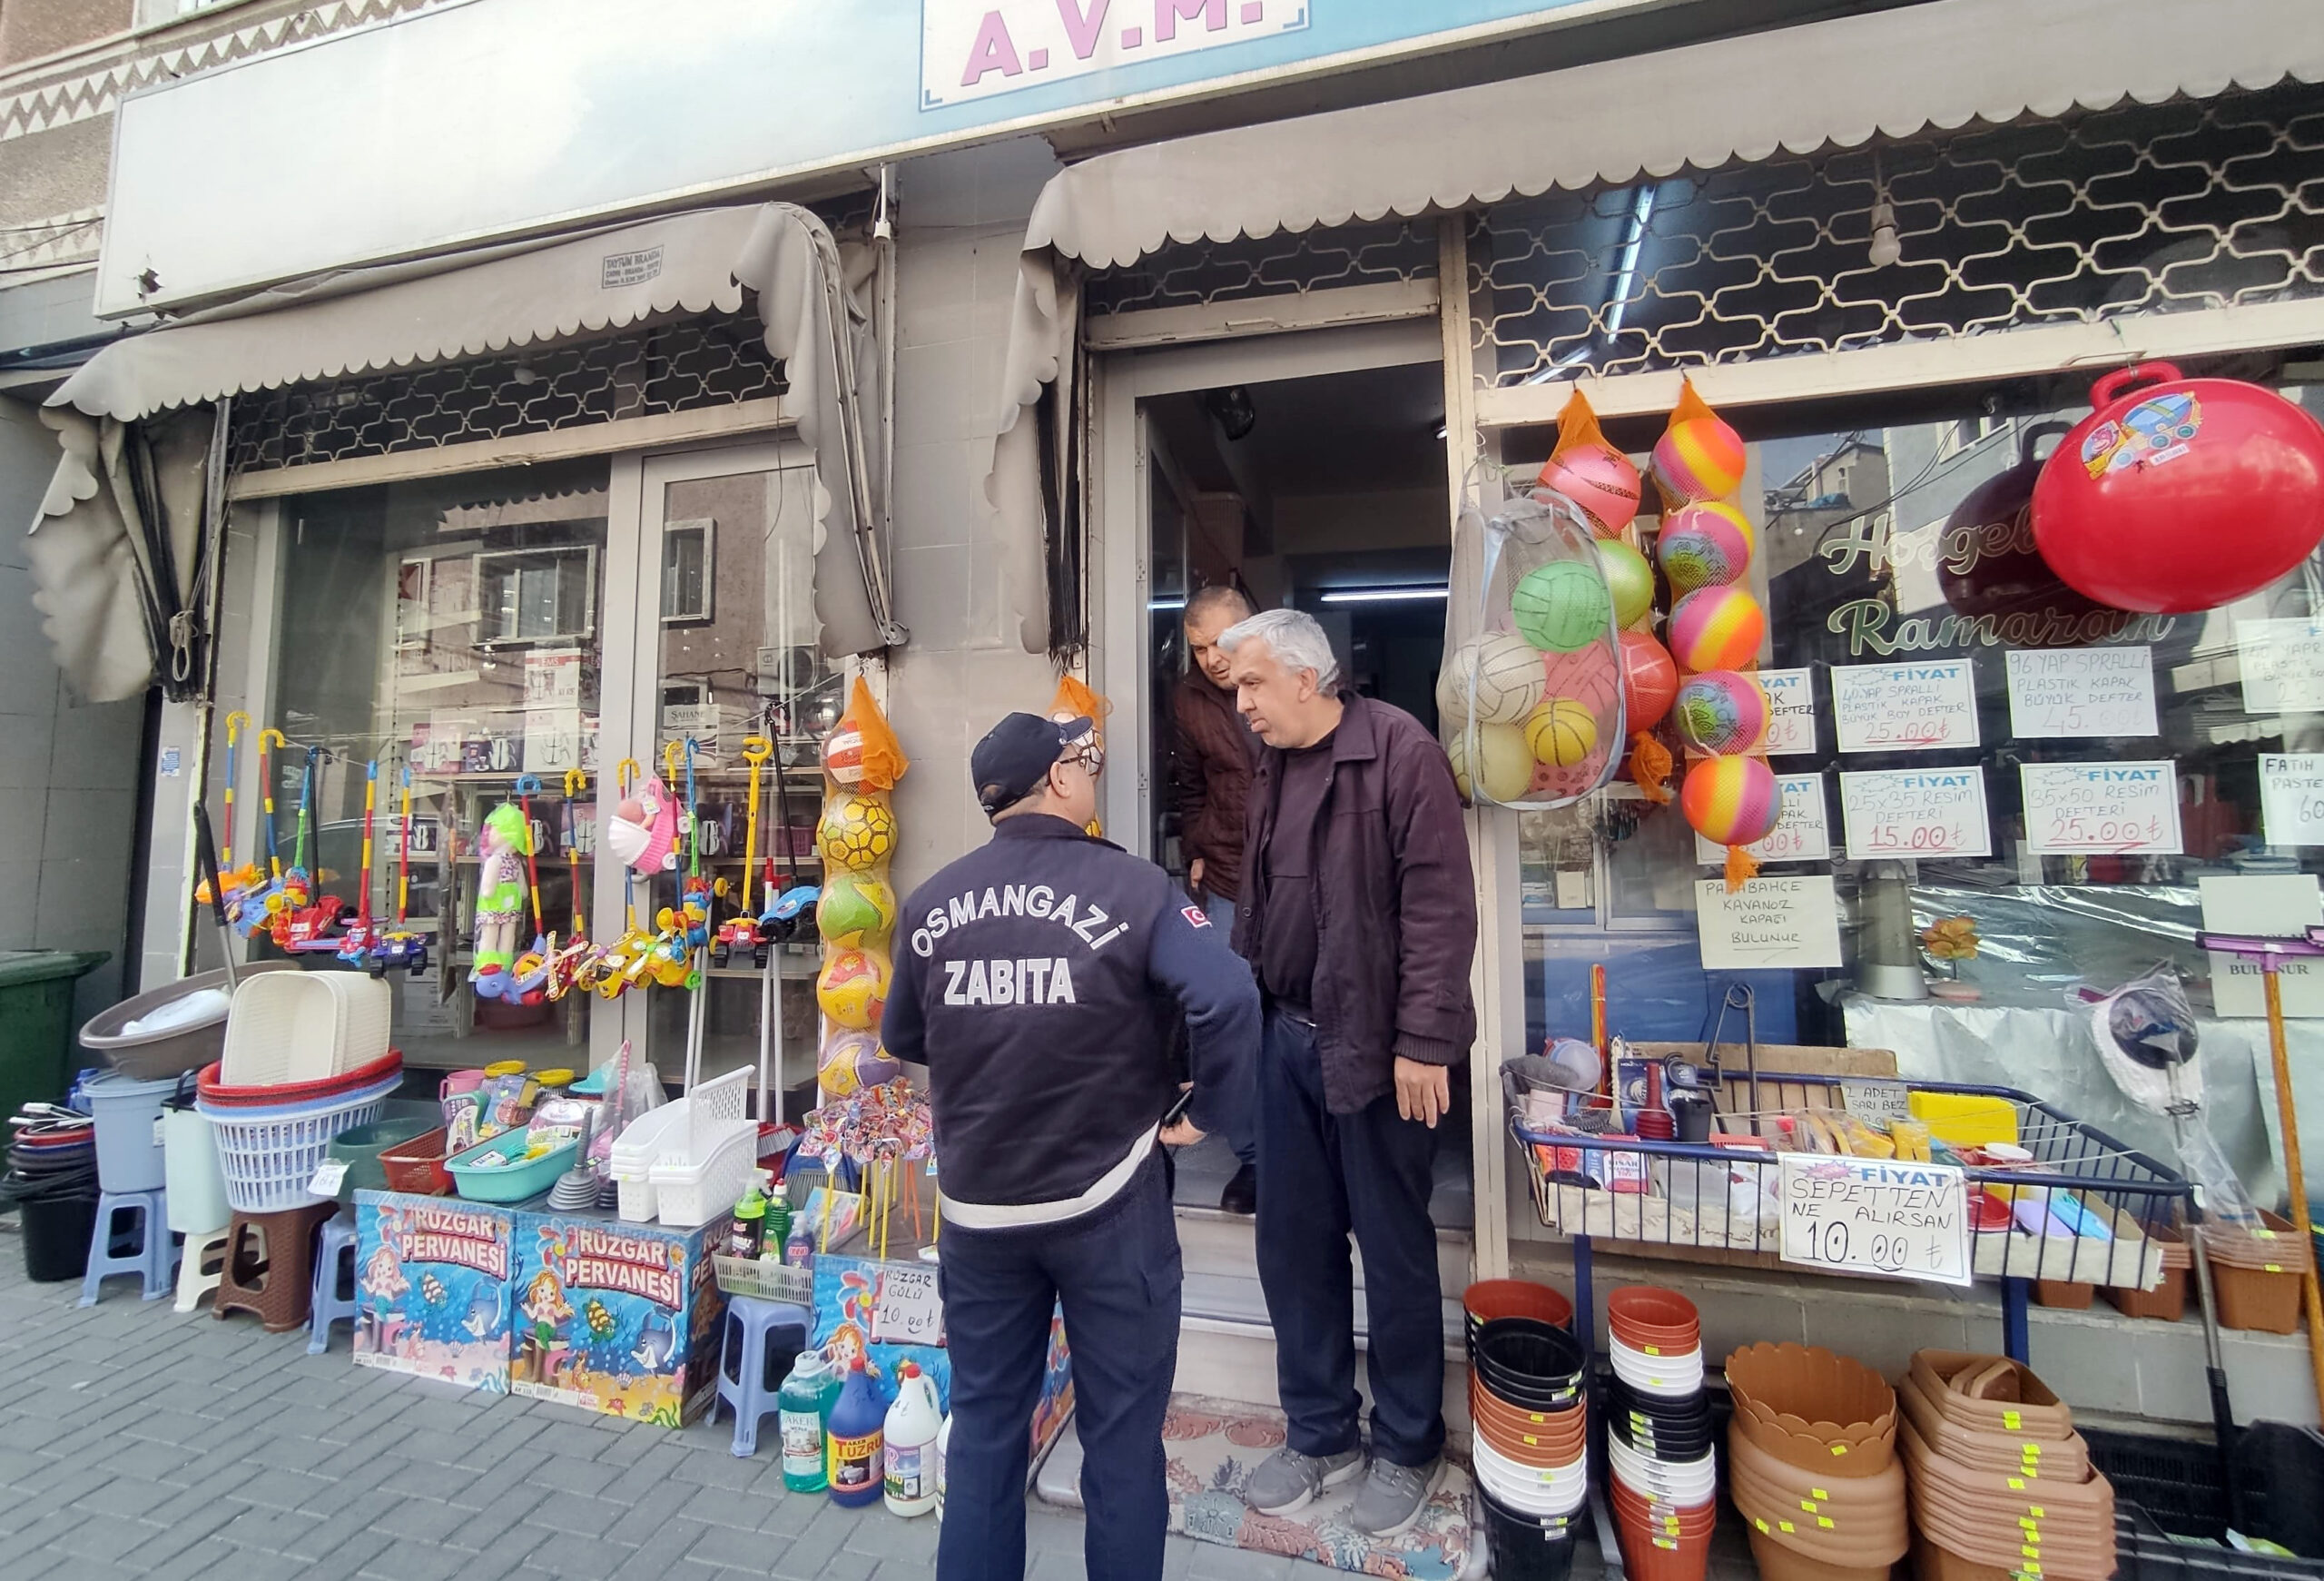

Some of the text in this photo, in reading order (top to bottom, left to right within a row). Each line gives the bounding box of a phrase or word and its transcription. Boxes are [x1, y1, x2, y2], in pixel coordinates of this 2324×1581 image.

[960, 0, 1264, 86] A.V.M.
[1821, 503, 2036, 575] Hoşgel
[1827, 598, 2176, 656] Ramazan
[2280, 641, 2321, 656] YAPR
[2010, 652, 2034, 675] 96
[2038, 652, 2071, 674] YAP
[1893, 667, 1960, 681] FİYAT
[1760, 677, 1800, 687] YAT
[2091, 676, 2138, 690] KAPAK
[1902, 694, 1944, 707] KAPAK
[2088, 691, 2143, 704] DEFTER
[1888, 710, 1910, 720] BOY
[1918, 702, 1968, 716] DEFTER
[1904, 775, 1971, 788] FİYAT
[2088, 768, 2161, 781] FİYAT
[2271, 777, 2324, 792] PASTE
[2299, 795, 2324, 823] 60
[1706, 881, 1803, 896] PAABAHÇE
[1724, 899, 1794, 911] KAVANOZ
[1731, 932, 1801, 944] BULUNUR
[2230, 964, 2309, 975] BULNUR
[944, 958, 1077, 1005] ZABITA
[1864, 1087, 1903, 1098] ADET
[1852, 1100, 1907, 1110] SARI BEZ
[1861, 1165, 1948, 1187] FİYAT
[1790, 1179, 1954, 1209] SEPETTEN
[414, 1205, 494, 1238] RÜZGAR
[1792, 1202, 1954, 1230] NE ALIRSAN
[402, 1234, 507, 1276] PERVANESİ
[579, 1229, 666, 1266] RÜZGAR
[566, 1257, 679, 1306] PERVANESİ
[785, 1416, 814, 1427] AKER
[835, 1436, 883, 1457] TUZRU
